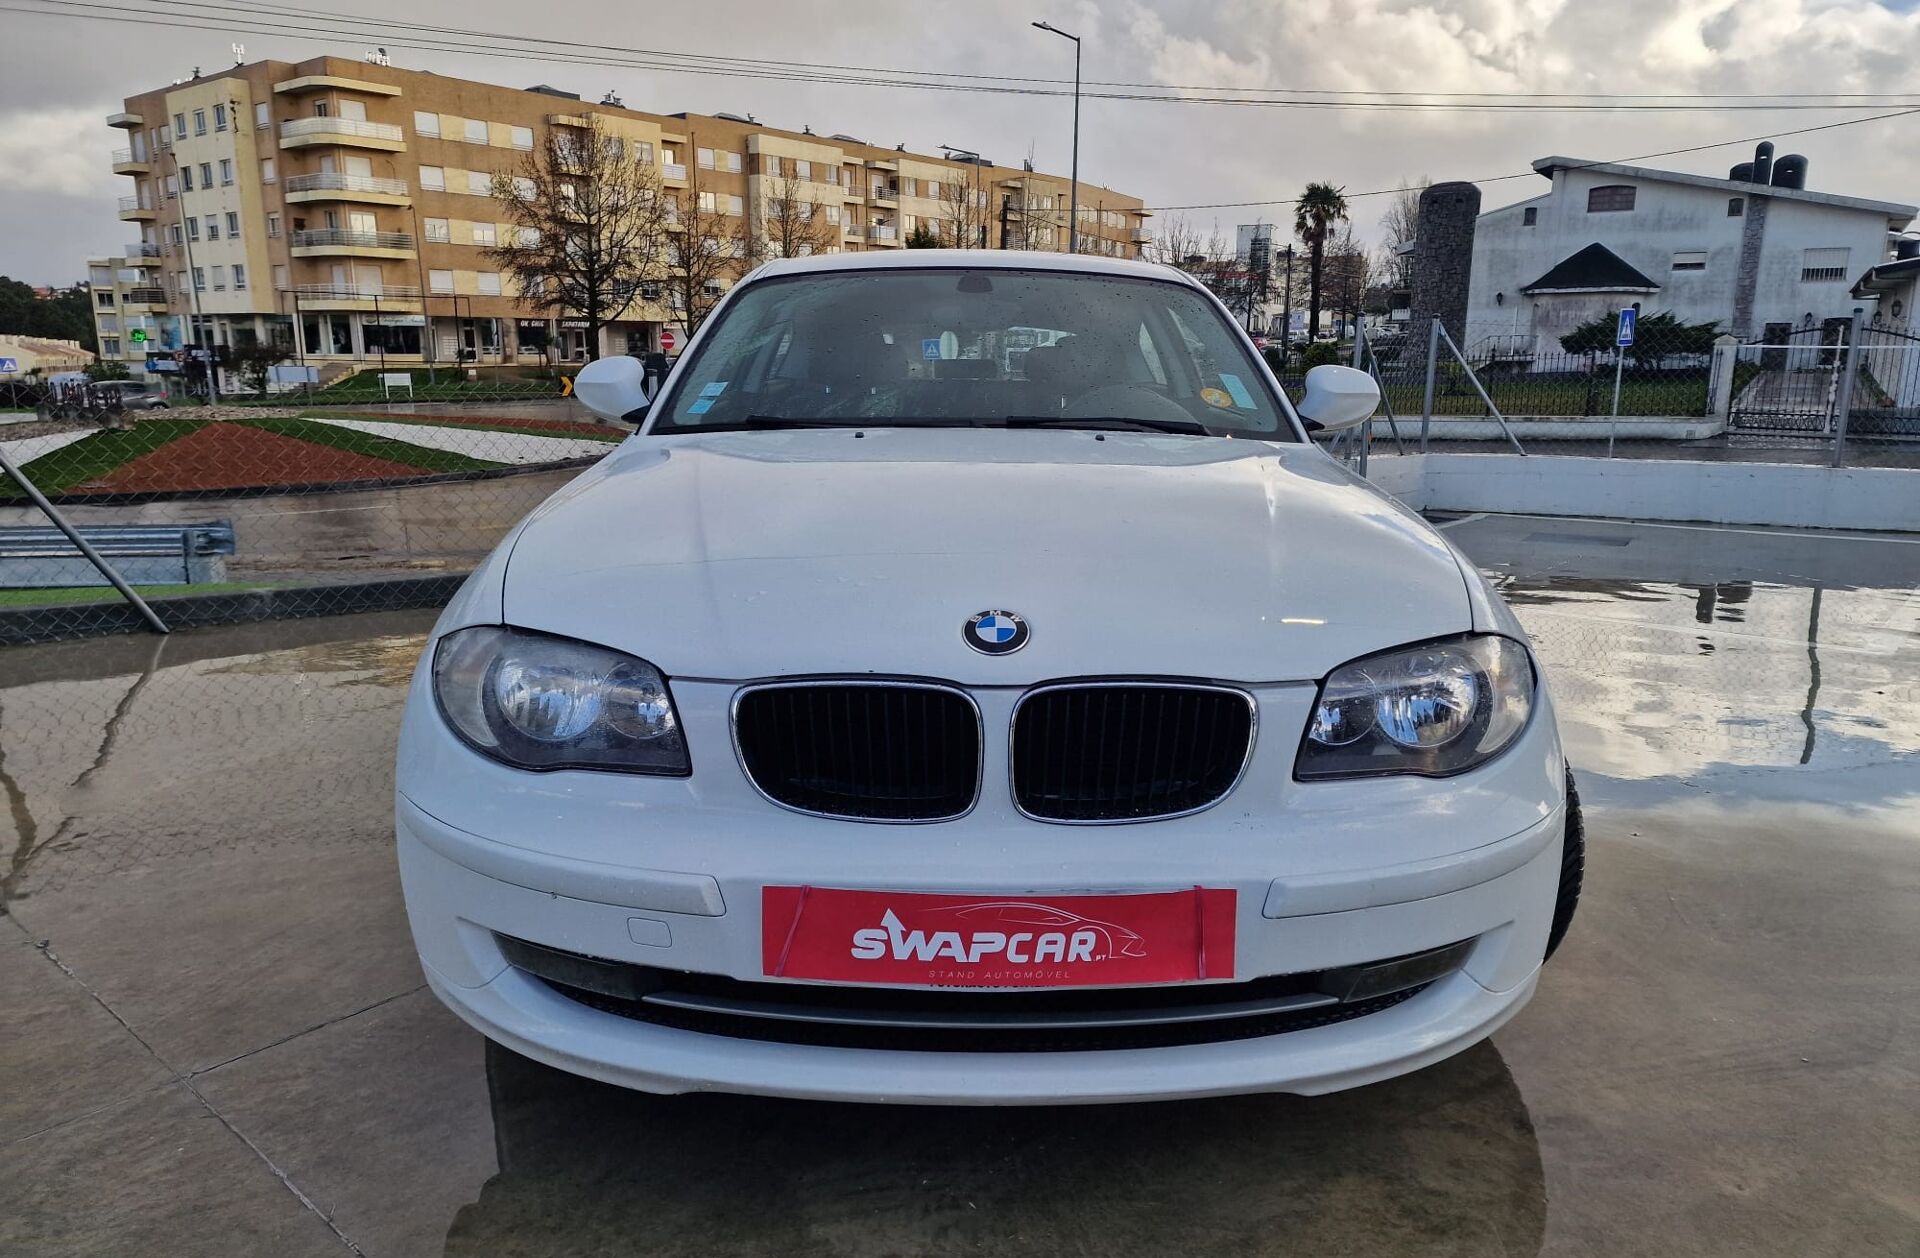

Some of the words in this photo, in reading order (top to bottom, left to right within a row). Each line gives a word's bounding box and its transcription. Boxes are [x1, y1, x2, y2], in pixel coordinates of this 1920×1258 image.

[970, 610, 1023, 622] BMW
[851, 912, 1096, 963] SWAPCAR
[928, 970, 975, 979] STAND
[983, 968, 1071, 979] AUTOMÓVEL
